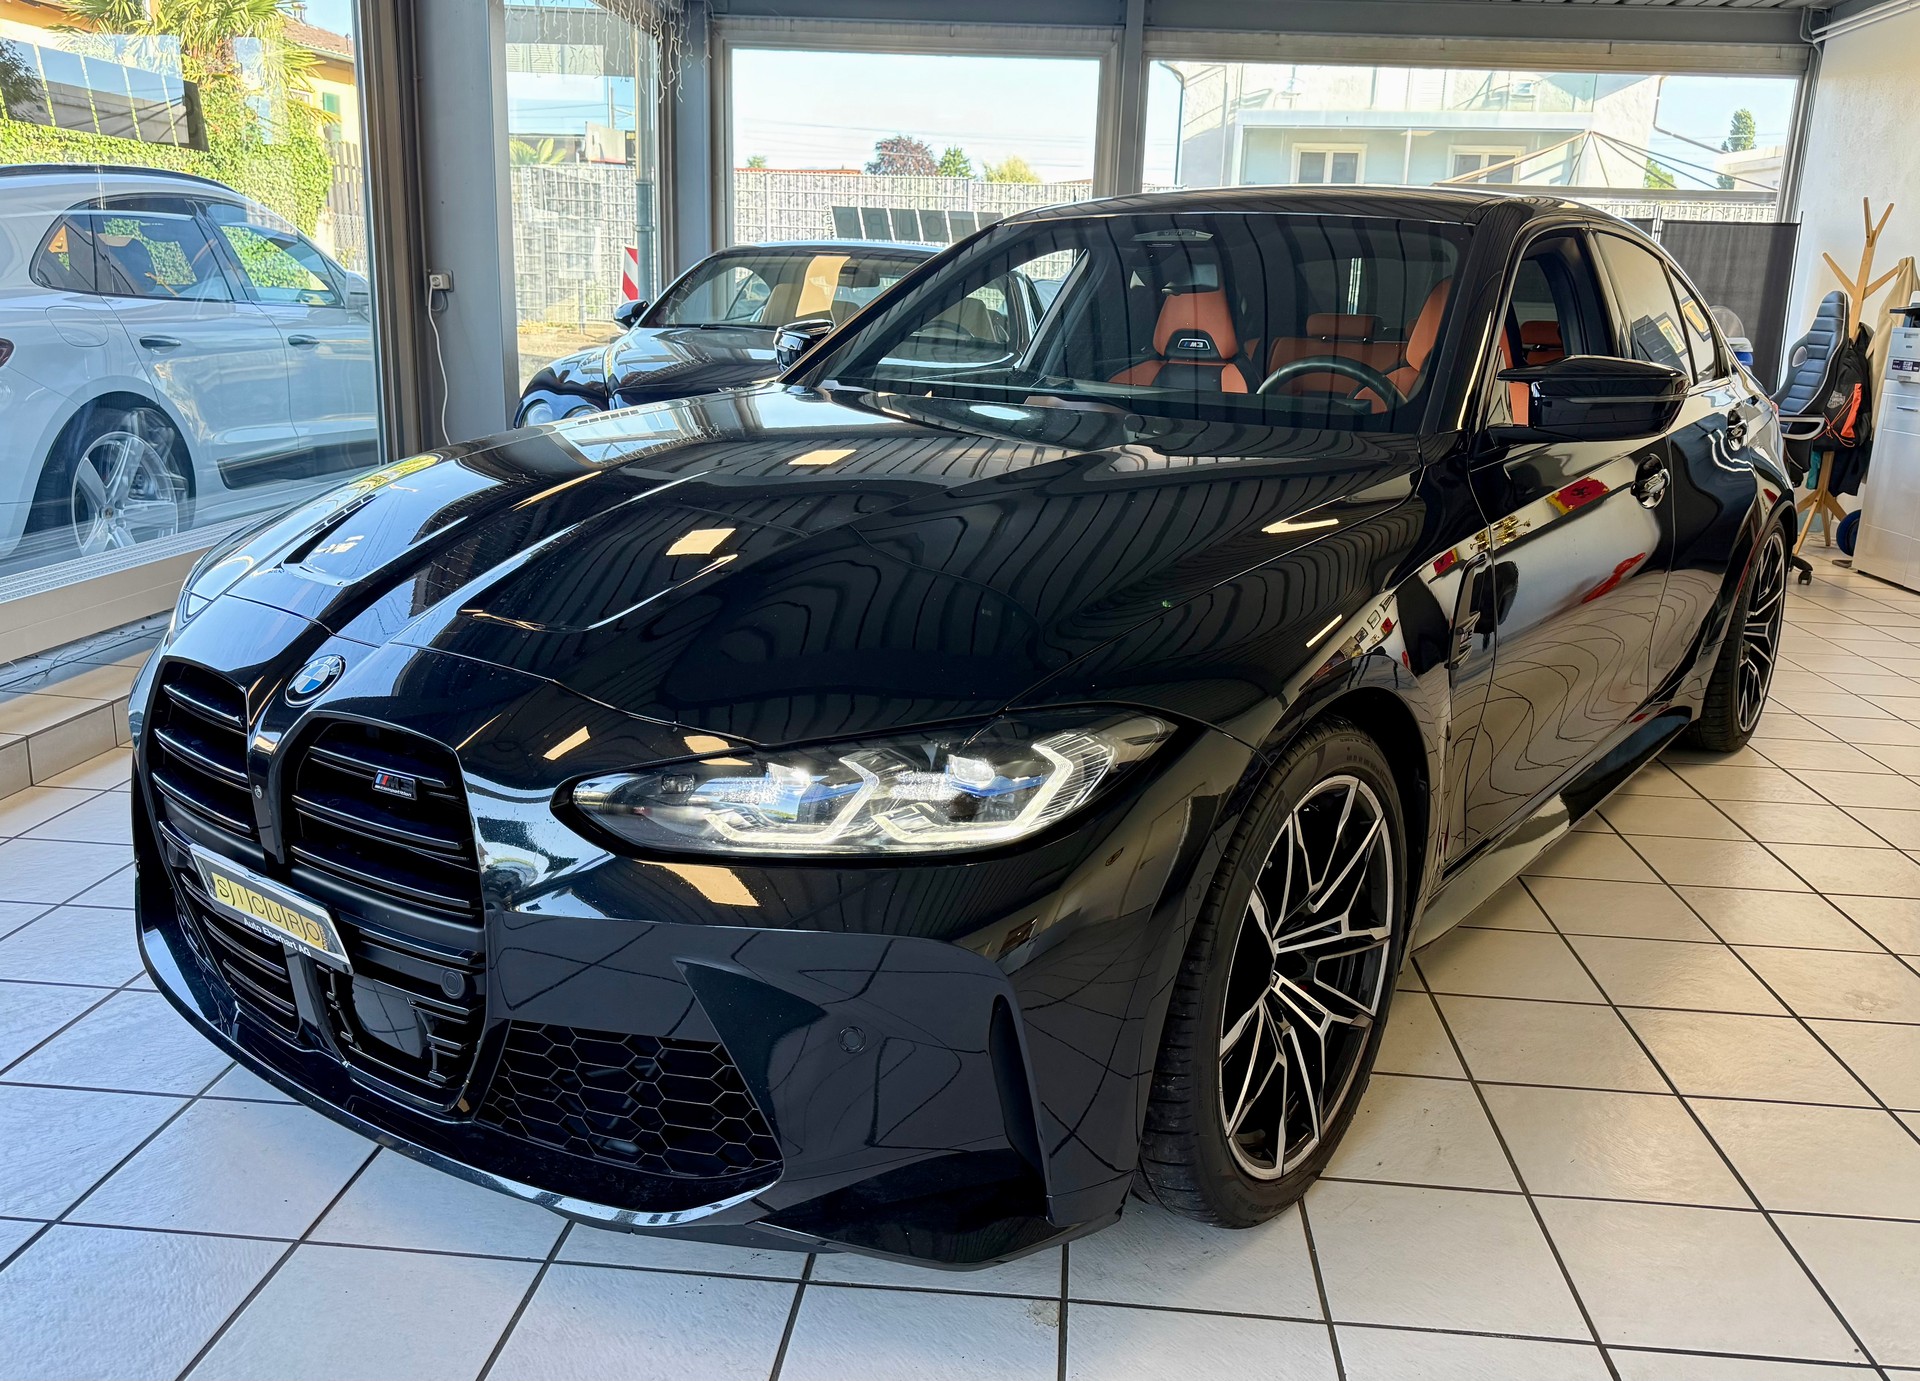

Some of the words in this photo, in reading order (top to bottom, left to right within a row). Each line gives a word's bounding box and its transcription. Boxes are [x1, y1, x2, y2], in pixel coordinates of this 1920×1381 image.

[216, 878, 321, 942] SICURO
[243, 917, 262, 933] Auto
[298, 944, 312, 957] AG
